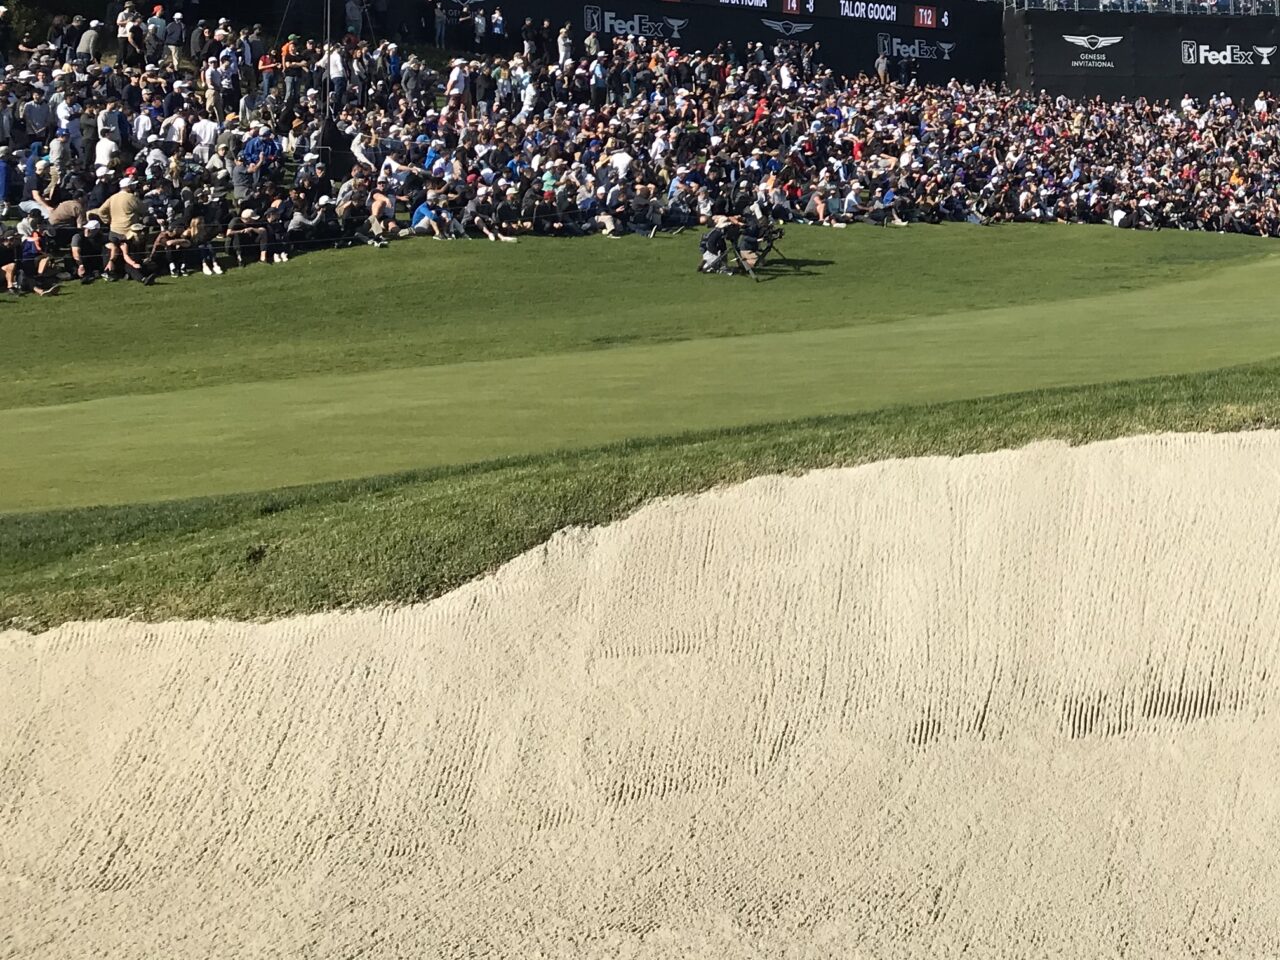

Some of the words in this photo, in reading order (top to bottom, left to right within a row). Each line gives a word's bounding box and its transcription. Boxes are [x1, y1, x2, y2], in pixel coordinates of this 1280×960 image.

[604, 12, 664, 37] FedEx
[839, 0, 866, 19] TALOR
[867, 3, 897, 22] GOOCH
[919, 8, 932, 25] T12
[941, 11, 949, 27] -6
[892, 37, 938, 59] FedEx
[1199, 44, 1254, 65] FedEx
[1071, 60, 1115, 68] INVITATIONAL
